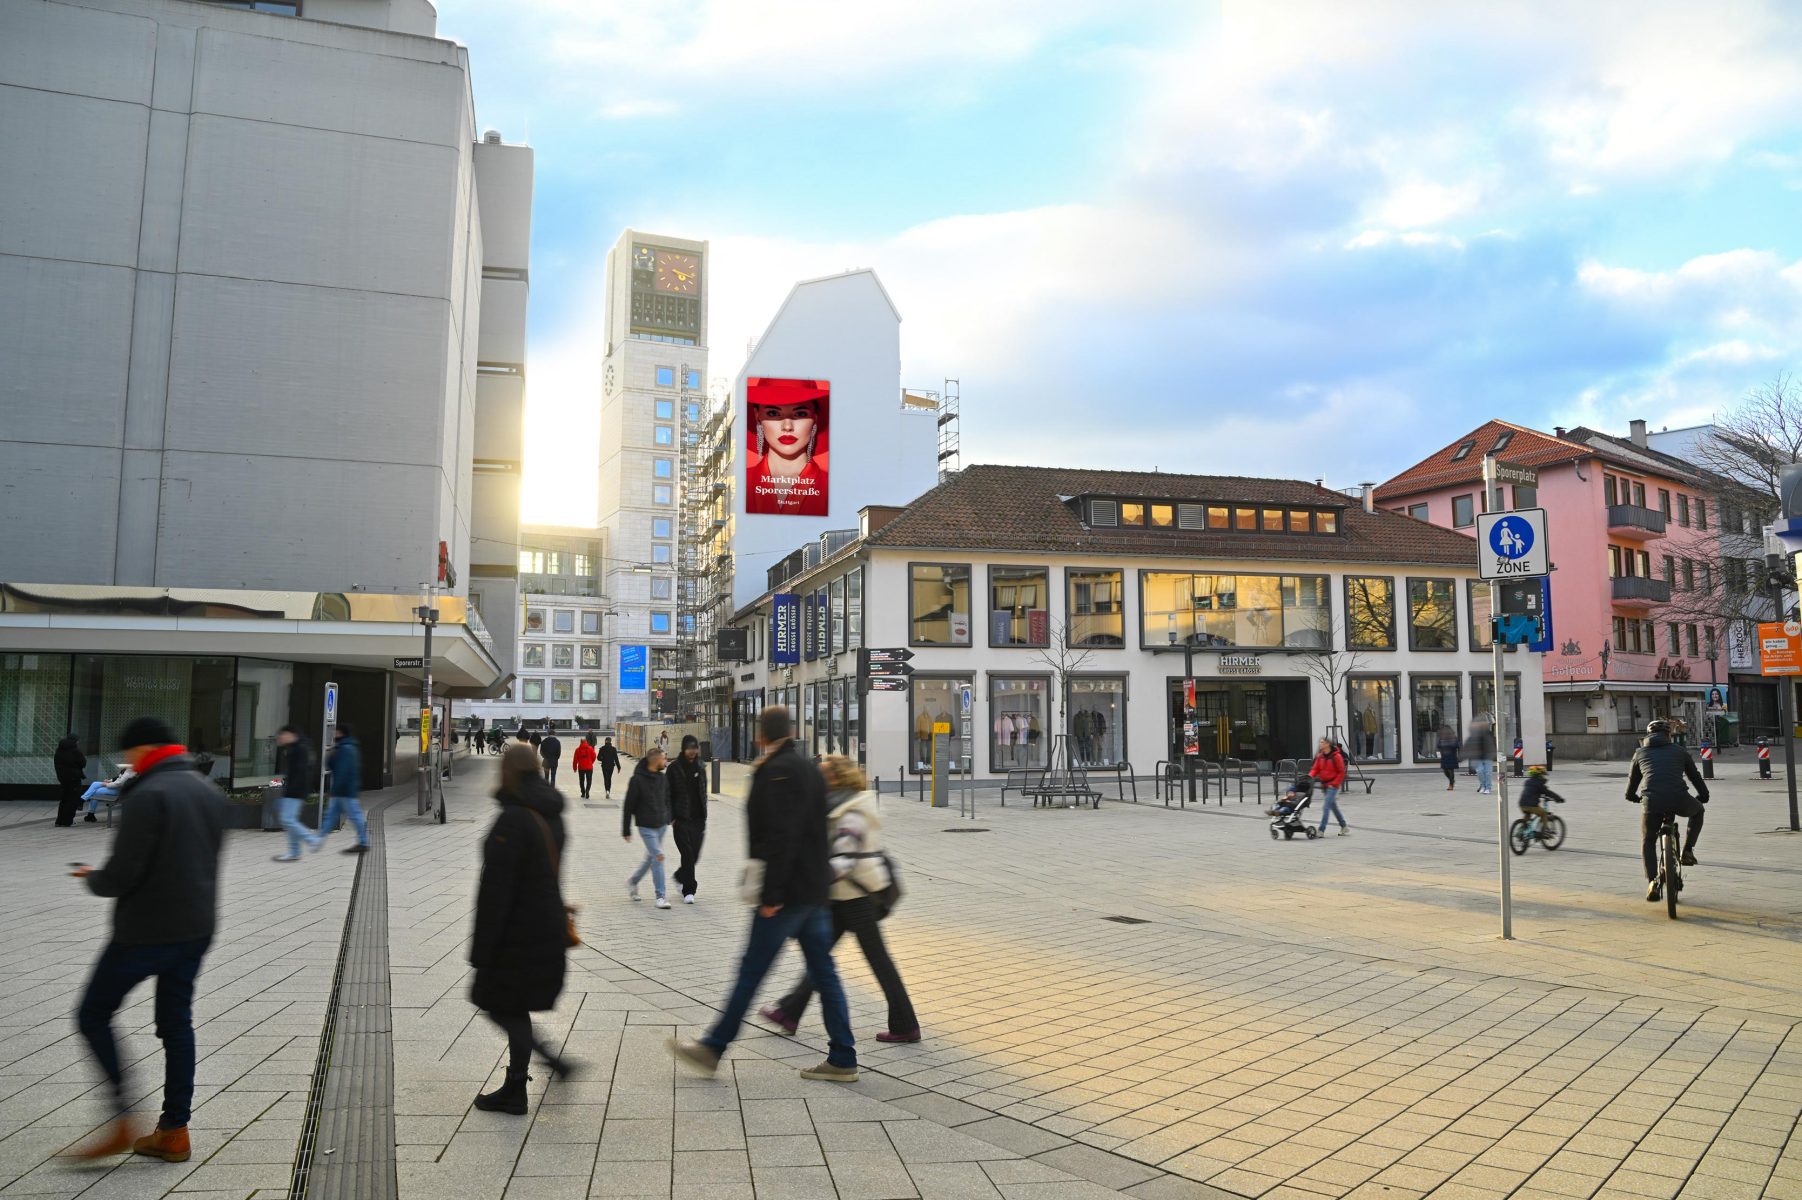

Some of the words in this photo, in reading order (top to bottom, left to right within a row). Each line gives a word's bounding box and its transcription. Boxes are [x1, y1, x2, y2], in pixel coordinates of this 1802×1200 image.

[1496, 464, 1536, 483] Sporerplatz
[761, 475, 816, 485] Marktplatz
[755, 486, 820, 496] Sporerstraße
[1496, 561, 1531, 574] ZONE
[777, 605, 787, 652] HIRMER
[395, 659, 422, 667] Sporerstr.
[1220, 656, 1262, 666] HIRMER
